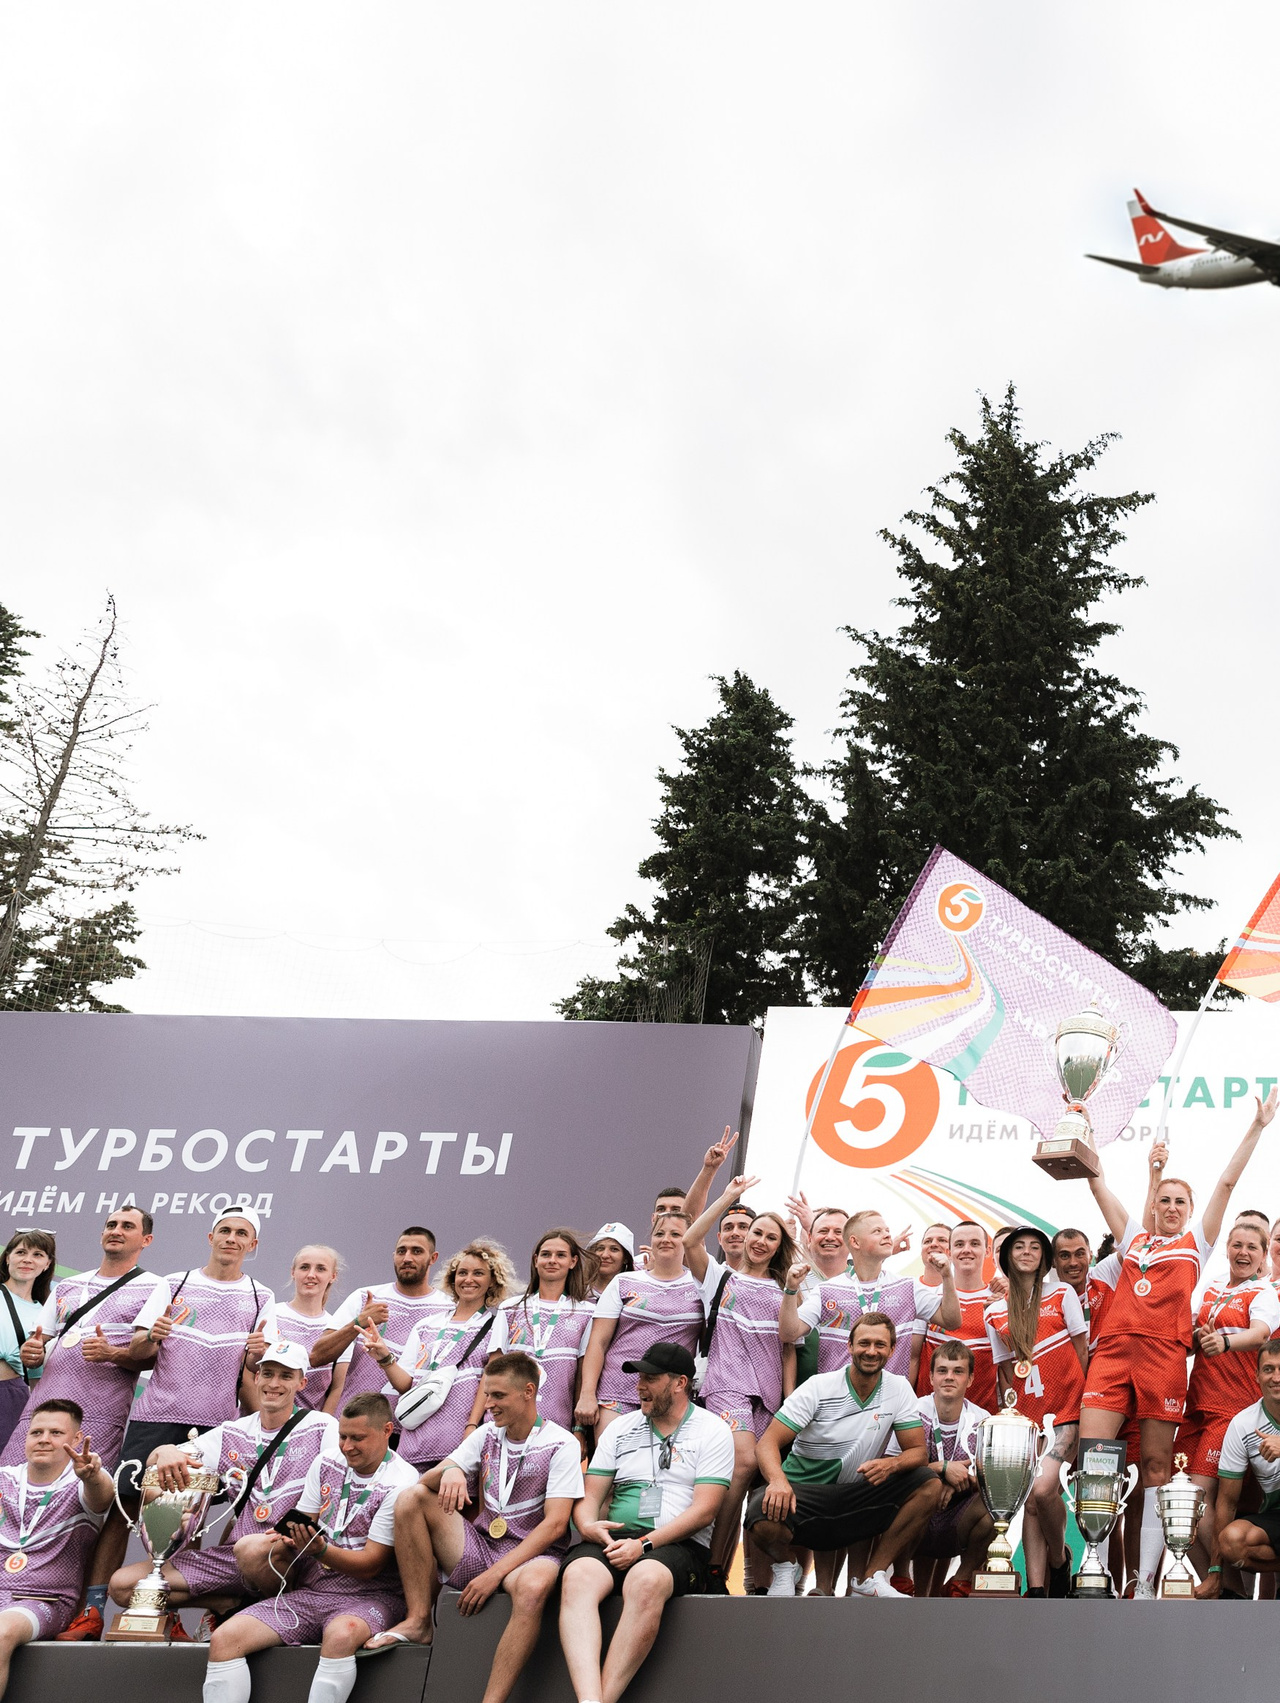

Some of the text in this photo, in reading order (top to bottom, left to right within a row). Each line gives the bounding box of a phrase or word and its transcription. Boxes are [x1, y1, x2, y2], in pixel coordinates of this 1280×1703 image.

[989, 914, 1121, 1013] ТУРБОСТАРТЫ
[949, 1119, 1018, 1143] ИДЁМ
[11, 1126, 514, 1176] ТУРБОСТАРТЫ
[0, 1185, 274, 1219] ИДЁМ НА РЕКОРД
[1024, 1365, 1045, 1398] 4
